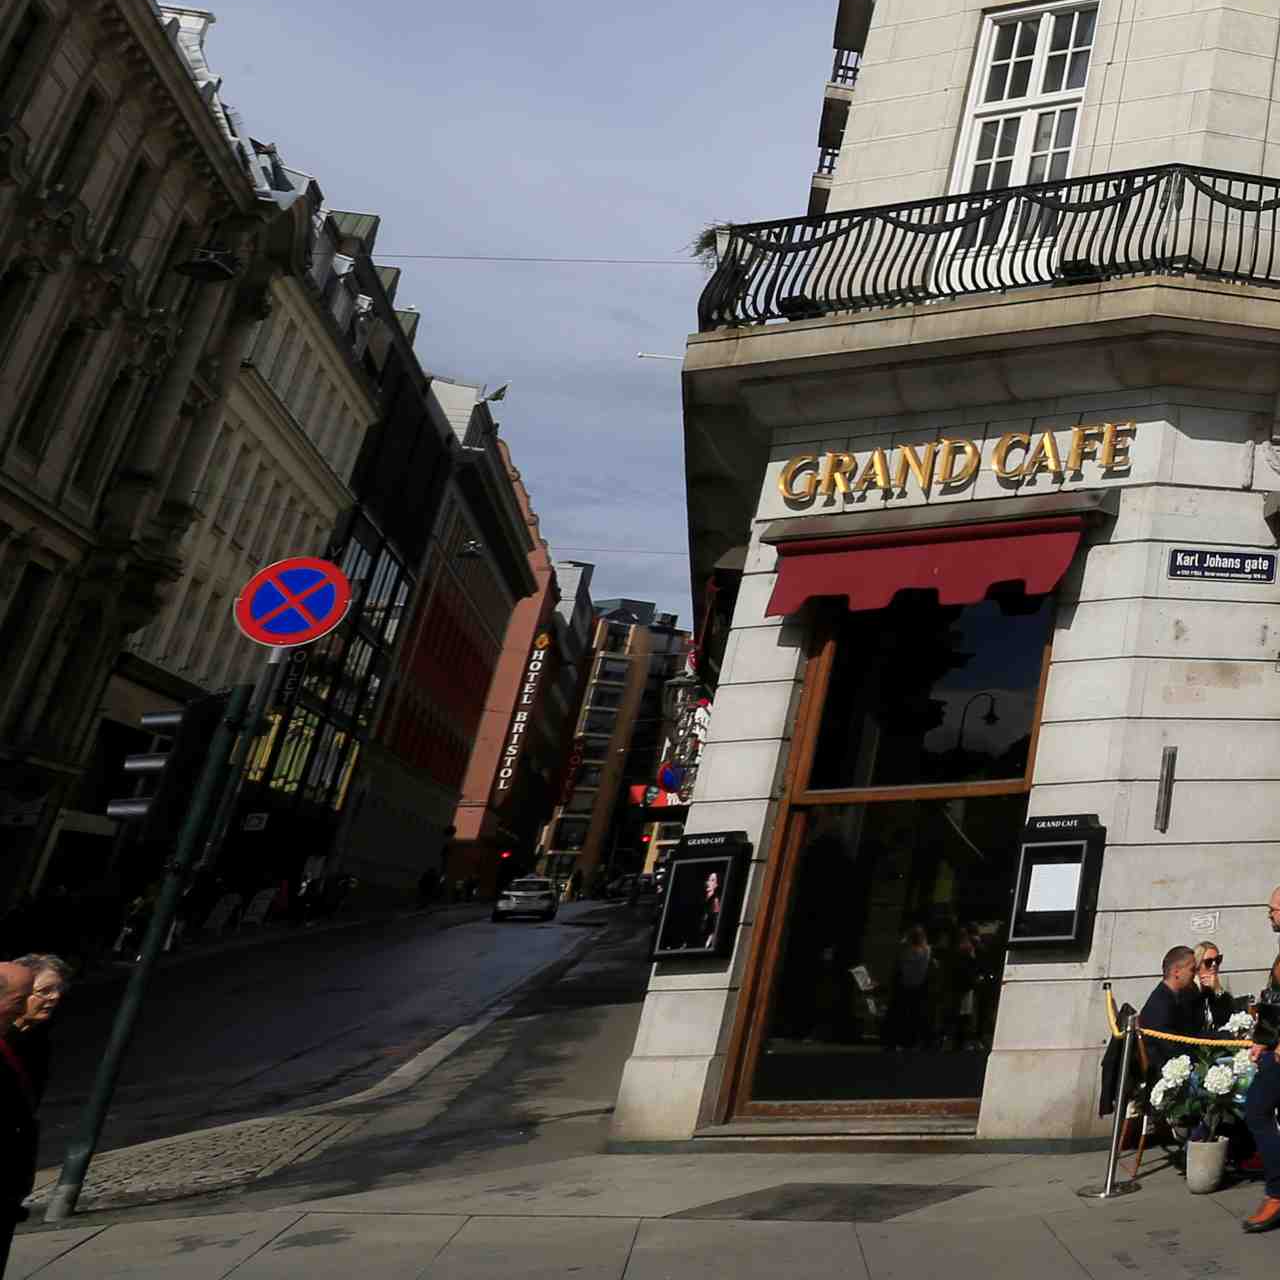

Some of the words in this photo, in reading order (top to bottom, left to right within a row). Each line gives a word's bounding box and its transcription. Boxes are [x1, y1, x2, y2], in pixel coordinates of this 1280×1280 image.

[777, 437, 982, 500] GRAND
[991, 421, 1137, 482] CAFE
[1176, 552, 1199, 566] Karl
[1203, 554, 1241, 569] Johans
[1244, 557, 1269, 573] gate
[521, 649, 545, 705] HOTEL
[497, 711, 528, 790] BRISTOL
